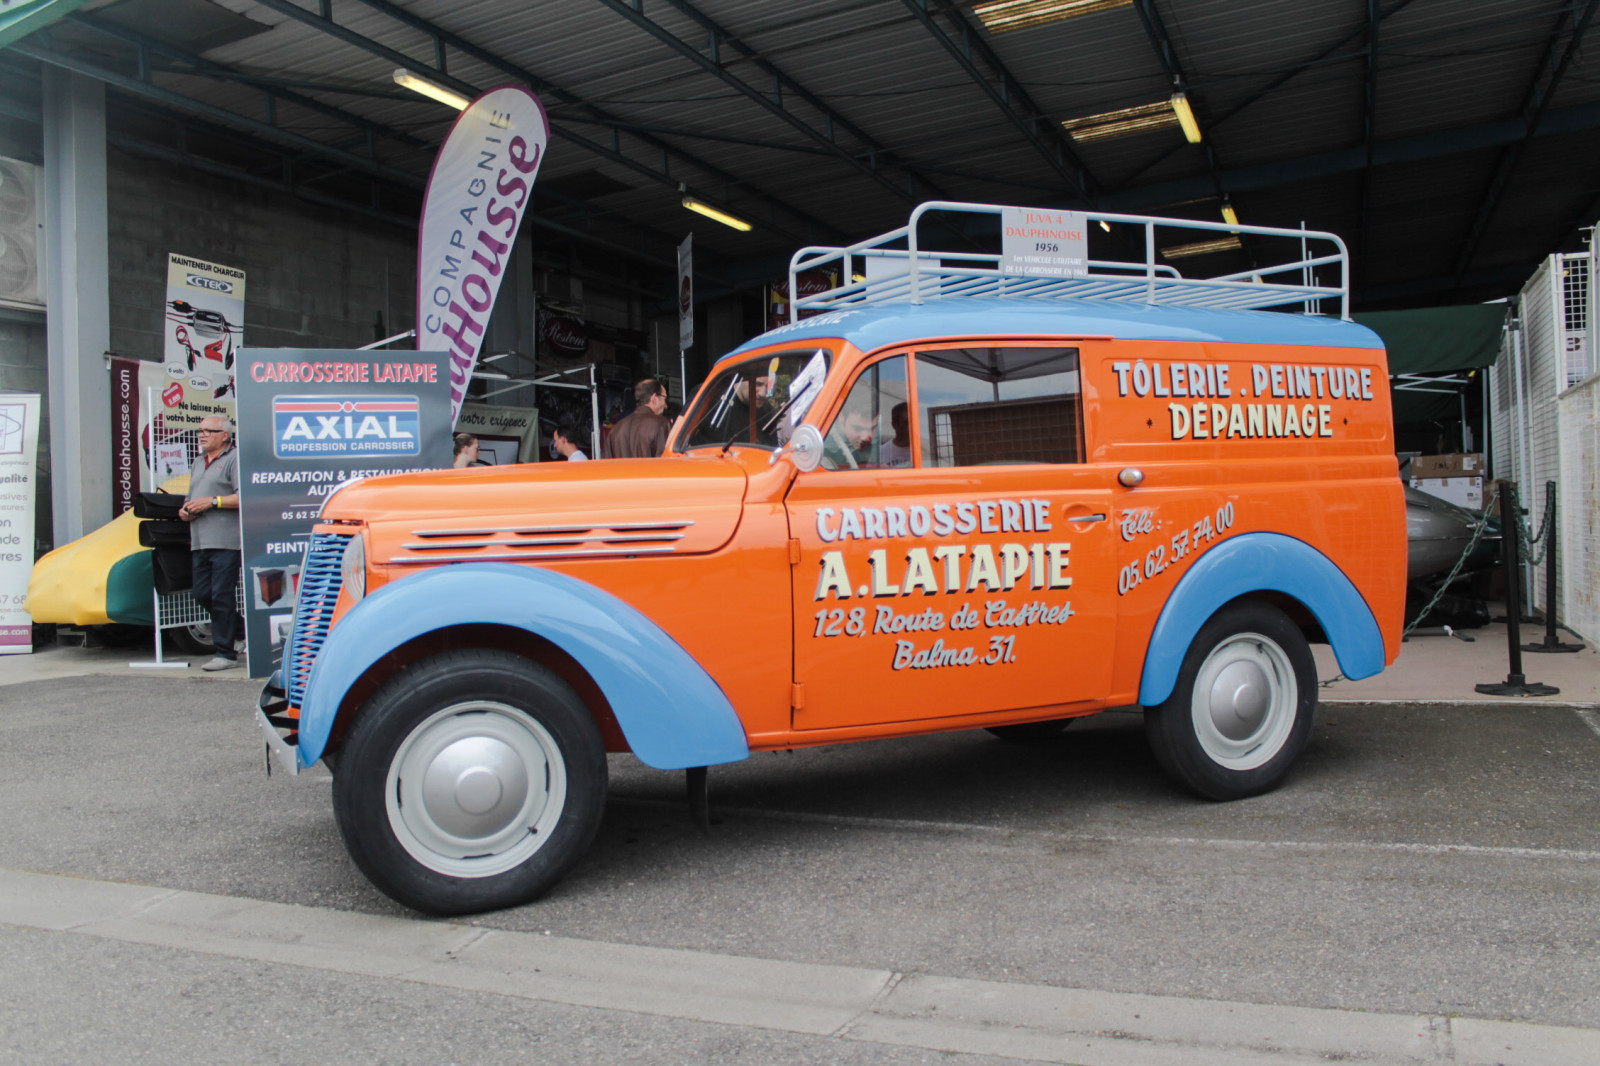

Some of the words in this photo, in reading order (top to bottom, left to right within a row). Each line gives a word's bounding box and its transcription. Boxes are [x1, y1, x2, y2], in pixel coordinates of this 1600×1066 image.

[425, 110, 511, 334] COMPAGNIE
[1026, 213, 1053, 224] JUVA
[1056, 215, 1063, 224] 4
[1006, 227, 1083, 240] DAUPHINOISE
[1035, 242, 1059, 252] 1956
[171, 256, 212, 272] MAINTENEUR
[213, 266, 245, 280] CHARGEUR
[1024, 266, 1062, 275] CARROSSERIE
[195, 277, 223, 290] CTEK
[250, 361, 369, 382] CARROSSERIE
[373, 362, 437, 383] LATAPIE
[1113, 359, 1232, 398] TÔLERIE
[1252, 362, 1374, 399] PEINTURE
[178, 401, 189, 411] Ne
[190, 402, 212, 413] laissez
[213, 404, 227, 414] plus
[166, 413, 185, 423] votre
[460, 411, 487, 425] votre
[489, 415, 528, 432] exigence
[282, 415, 415, 440] AXIAL
[281, 442, 347, 452] PROFESSION
[350, 441, 415, 451] CARROSSIER
[252, 470, 334, 484] REPARATION
[337, 469, 347, 481] &
[281, 511, 294, 520] 05
[296, 511, 308, 519] 62
[309, 510, 321, 519] 57
[815, 499, 1053, 543] CARROSSERIE
[813, 606, 868, 638] 128,
[872, 604, 946, 634] Route
[949, 602, 979, 630] de
[983, 599, 1075, 629] Castres
